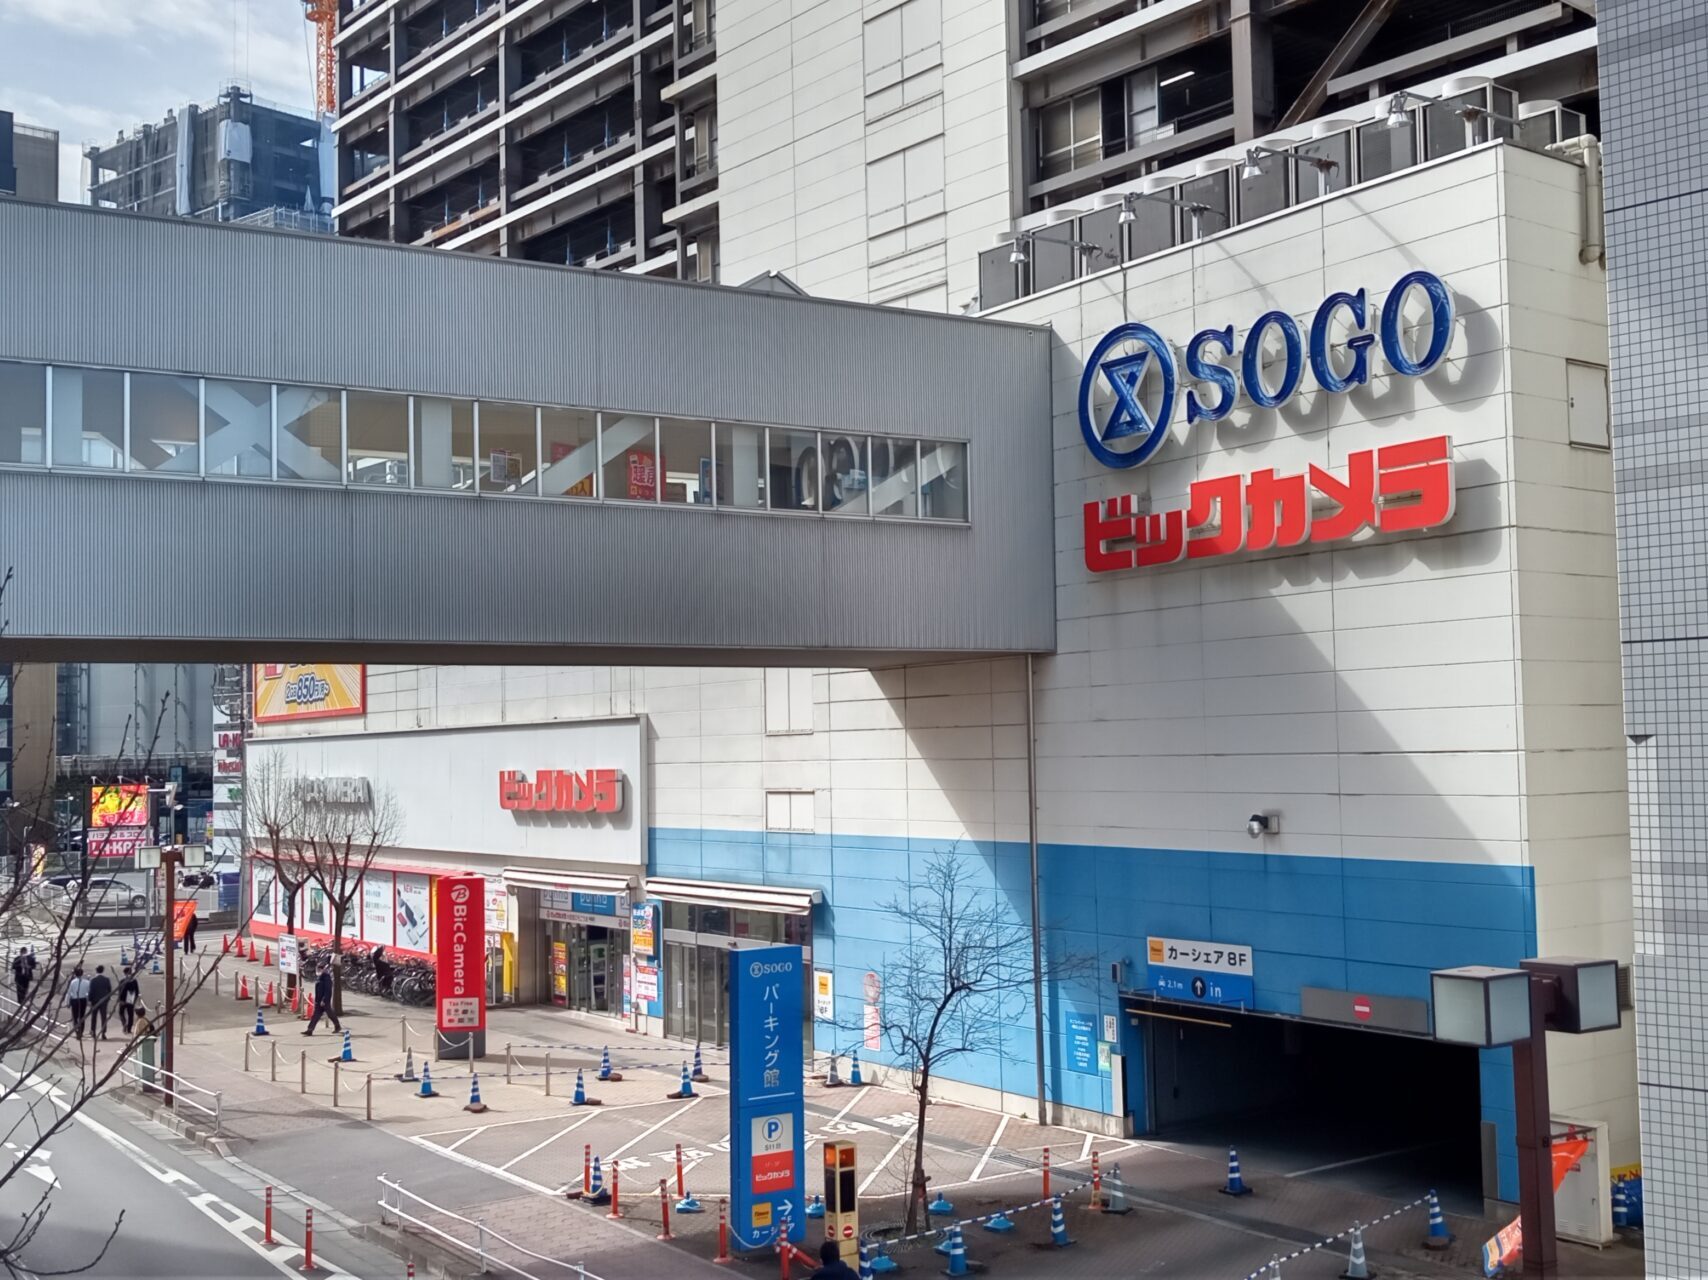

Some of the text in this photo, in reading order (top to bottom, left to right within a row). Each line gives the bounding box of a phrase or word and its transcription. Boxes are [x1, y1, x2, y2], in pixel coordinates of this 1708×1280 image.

[1186, 270, 1455, 425] SOGO
[1083, 435, 1456, 573] ビックカメラ
[499, 769, 623, 813] ビックカメラ
[453, 905, 467, 995] BicCamera
[763, 962, 792, 974] SOGO
[1210, 982, 1222, 997] in
[763, 983, 780, 1088] パーキング館
[768, 1121, 779, 1139] P
[755, 1169, 791, 1181] ビックカメラ
[752, 1223, 795, 1239] カーシア
